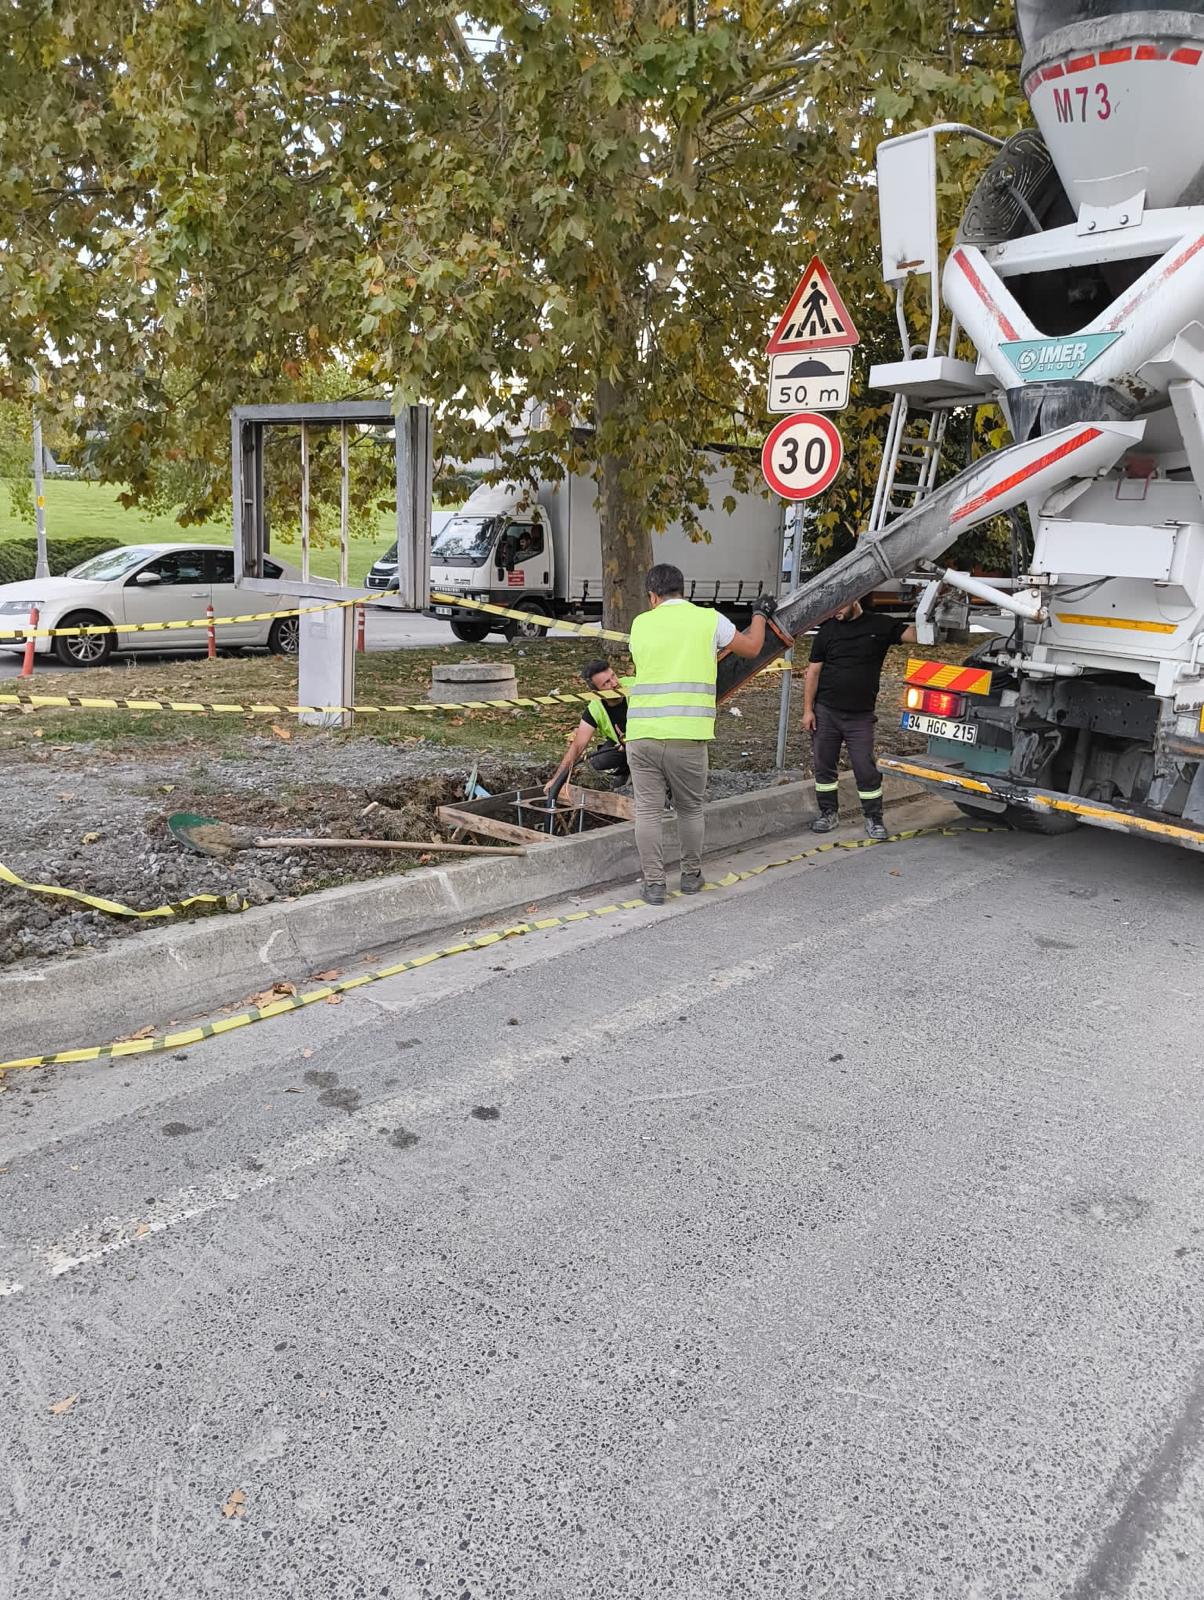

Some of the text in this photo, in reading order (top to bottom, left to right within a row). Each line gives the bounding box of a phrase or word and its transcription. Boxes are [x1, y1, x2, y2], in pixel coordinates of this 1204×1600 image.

[1053, 83, 1111, 123] M73
[1039, 343, 1087, 363] IMER
[779, 386, 839, 403] 50 m
[778, 437, 826, 475] 30
[908, 715, 975, 741] 34 HGC 215
